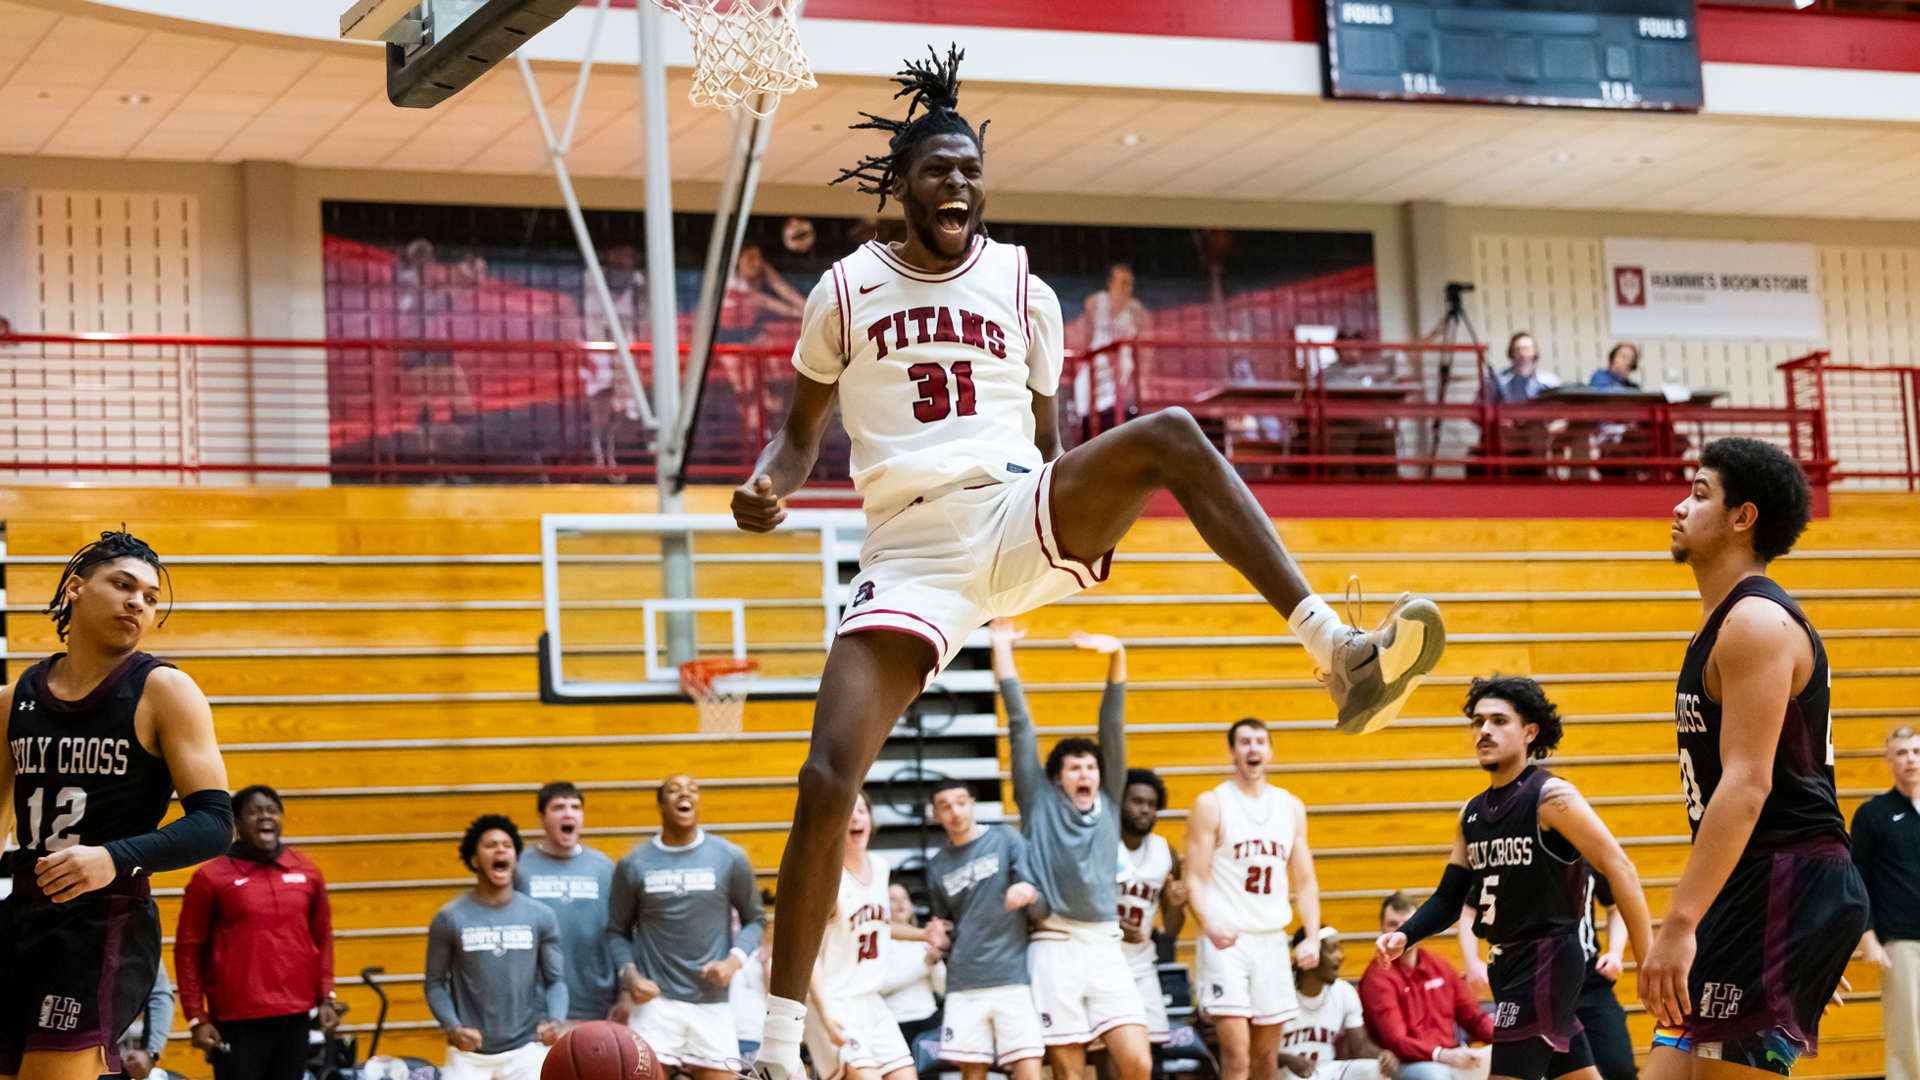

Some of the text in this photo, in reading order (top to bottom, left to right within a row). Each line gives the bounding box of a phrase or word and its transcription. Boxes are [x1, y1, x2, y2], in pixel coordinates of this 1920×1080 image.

[1342, 3, 1394, 25] FOULS
[1638, 17, 1687, 38] FOULS
[1720, 275, 1809, 294] BOOKSTORE
[867, 306, 1007, 361] TITANS
[907, 361, 978, 423] 31
[58, 737, 130, 775] CROSS
[26, 786, 88, 852] 12
[1234, 839, 1287, 861] TITANS
[1467, 836, 1533, 870] OLY CROSS
[1245, 865, 1272, 895] 21
[1479, 874, 1499, 926] 5
